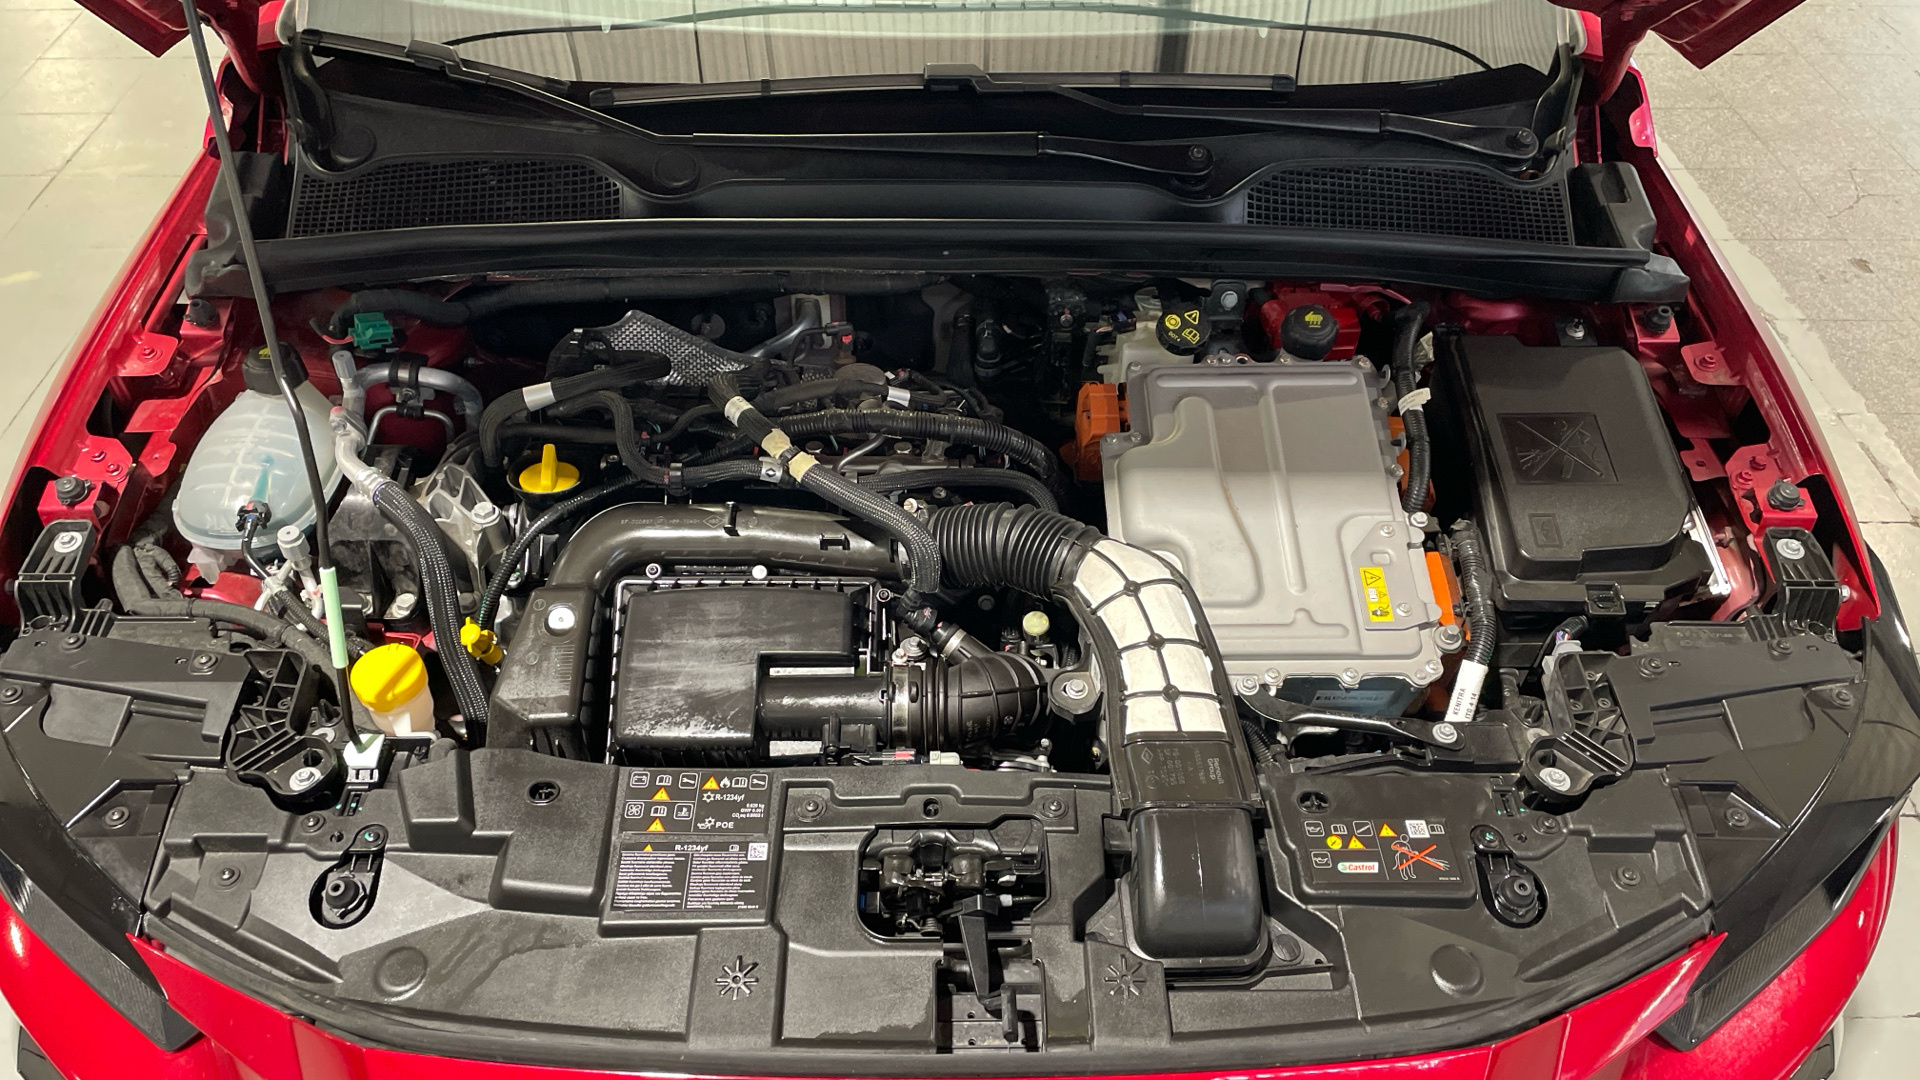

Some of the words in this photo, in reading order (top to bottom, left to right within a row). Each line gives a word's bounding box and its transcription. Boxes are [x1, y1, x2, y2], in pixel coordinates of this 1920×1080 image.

[1168, 330, 1179, 340] DOT
[1453, 688, 1466, 716] KENITRA
[1207, 758, 1216, 781] Group
[1213, 757, 1225, 784] Renault
[715, 793, 745, 802] R-1234yf
[715, 821, 734, 829] POE
[675, 844, 709, 853] R-1234yf
[1348, 863, 1375, 871] Castrol
